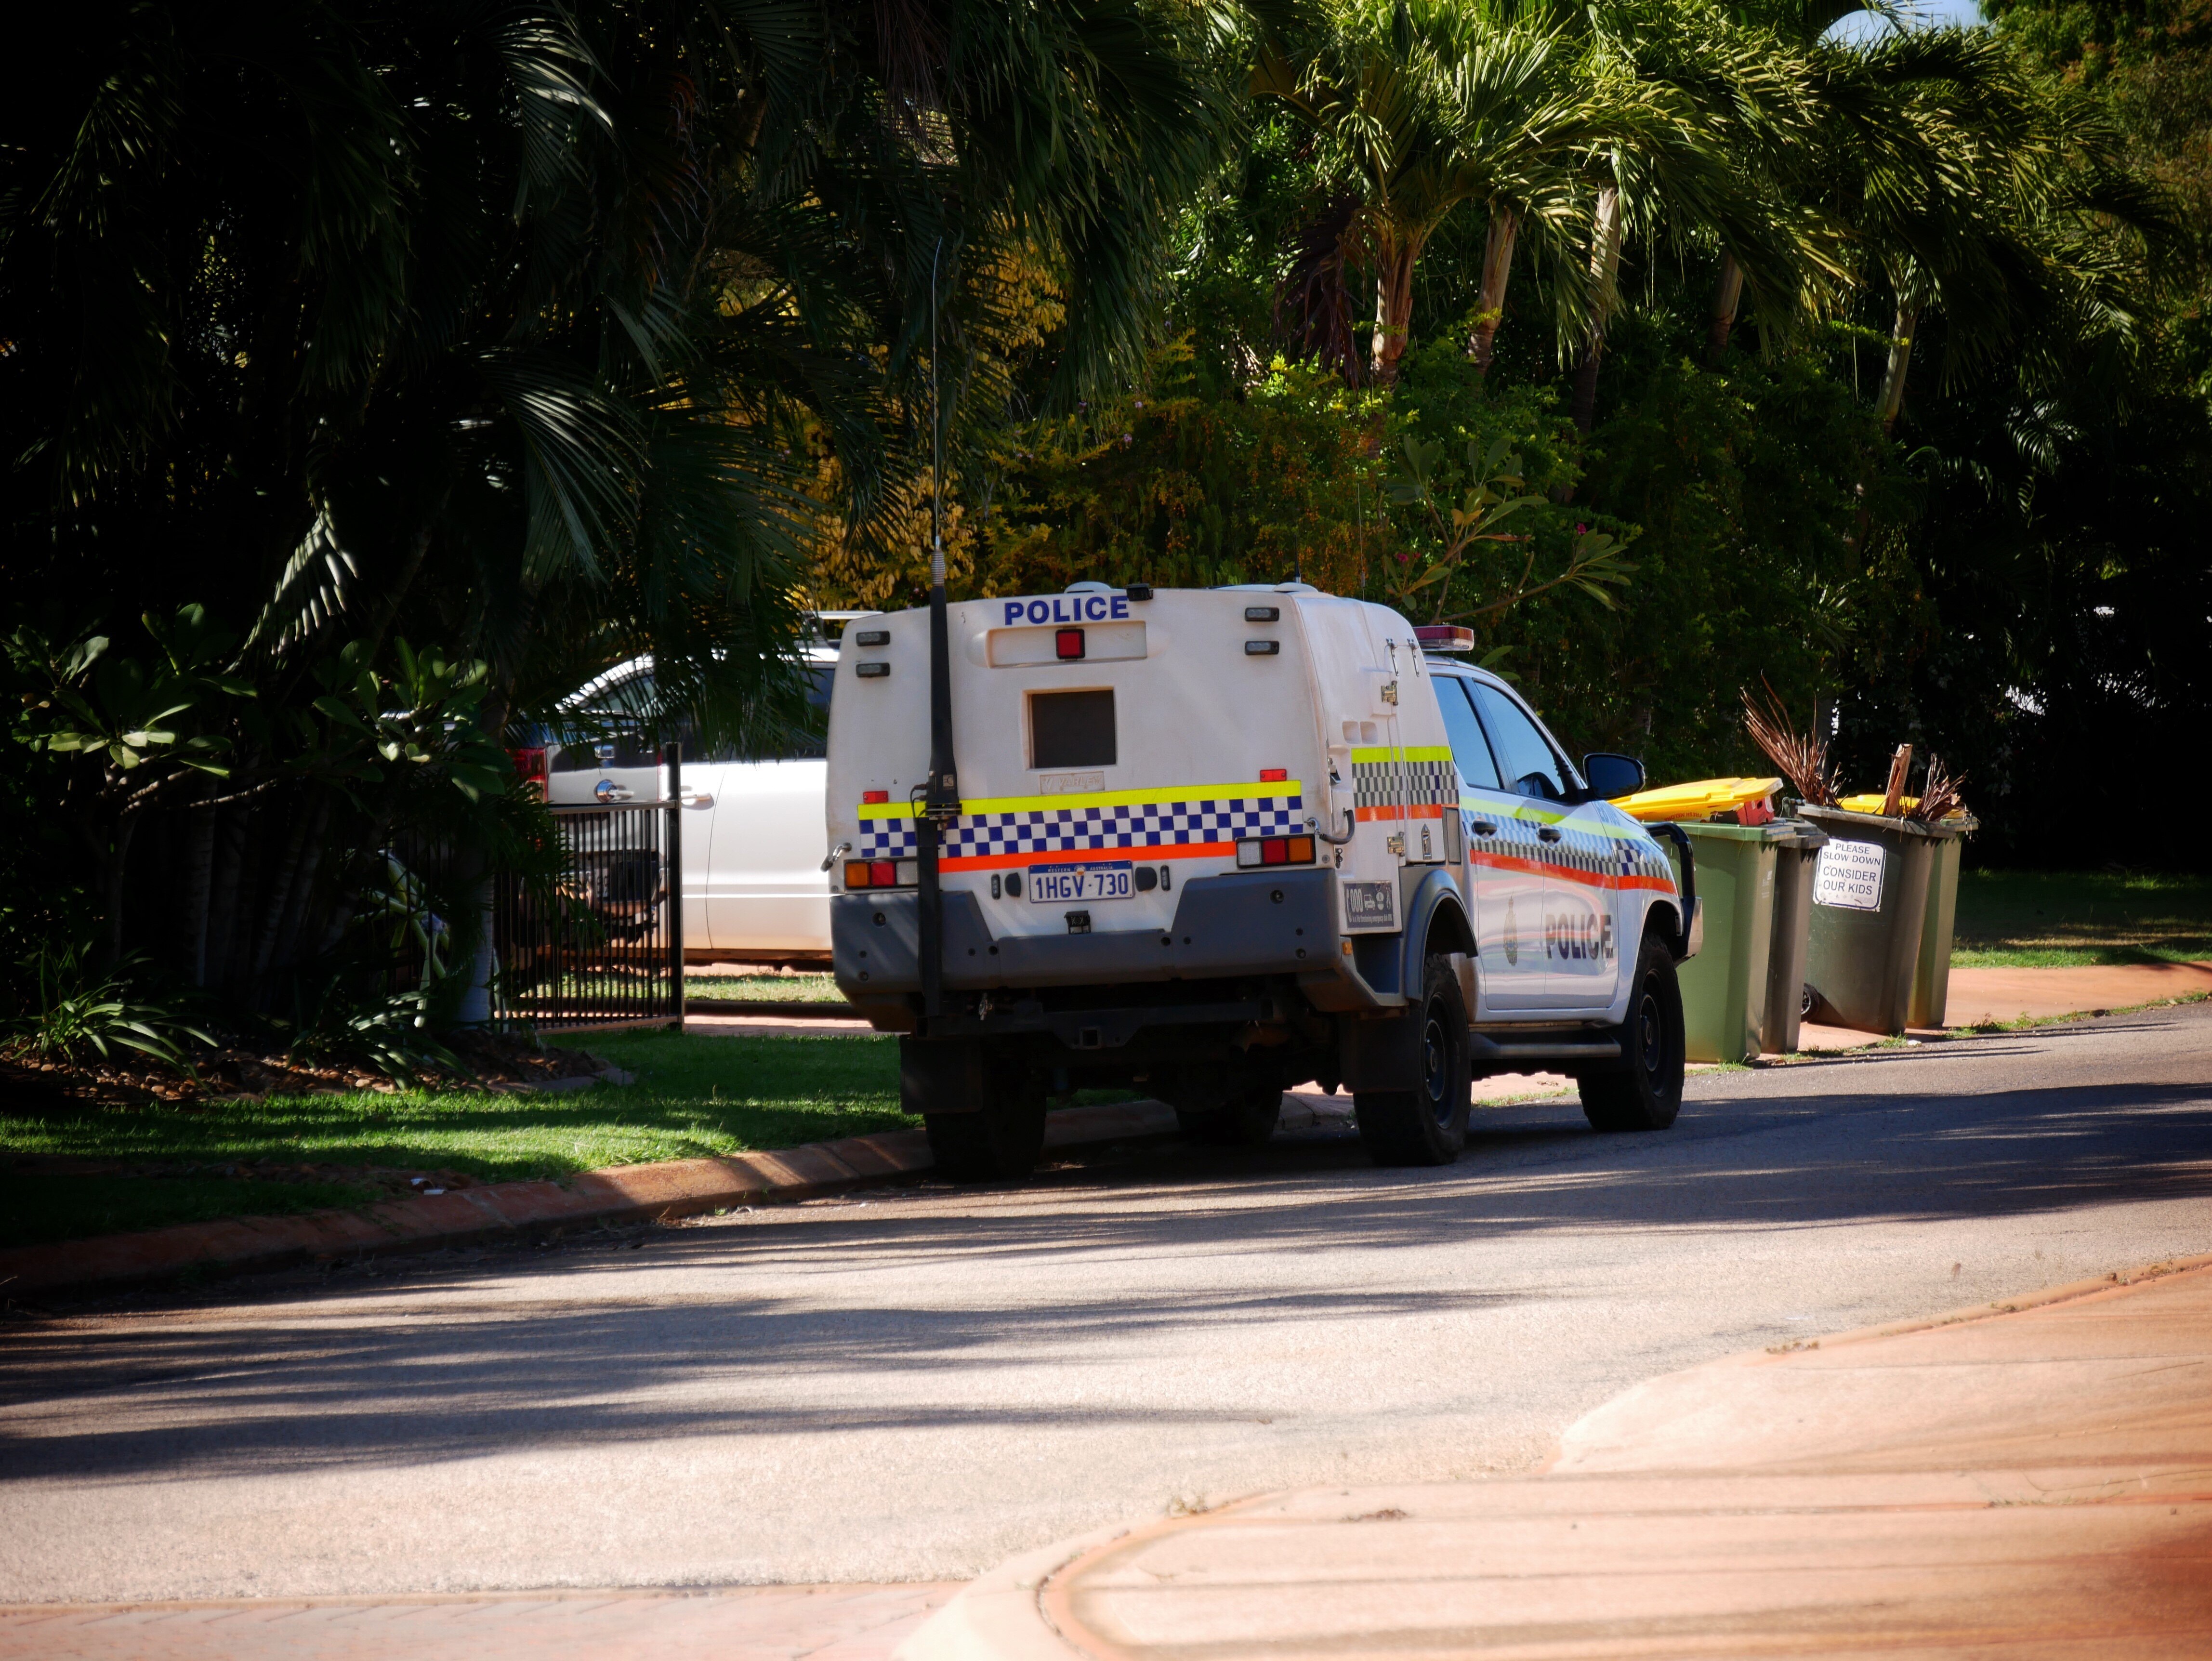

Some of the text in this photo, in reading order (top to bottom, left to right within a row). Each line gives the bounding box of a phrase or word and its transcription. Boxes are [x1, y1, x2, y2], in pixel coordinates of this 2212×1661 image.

[1004, 595, 1129, 625] POLICE
[1835, 844, 1870, 854] PLEASE
[1823, 852, 1881, 866] SLOW DOWN
[1823, 866, 1876, 882] CONSIDER
[1823, 880, 1872, 895] OUR KIDS
[1545, 913, 1614, 960] POLICE
